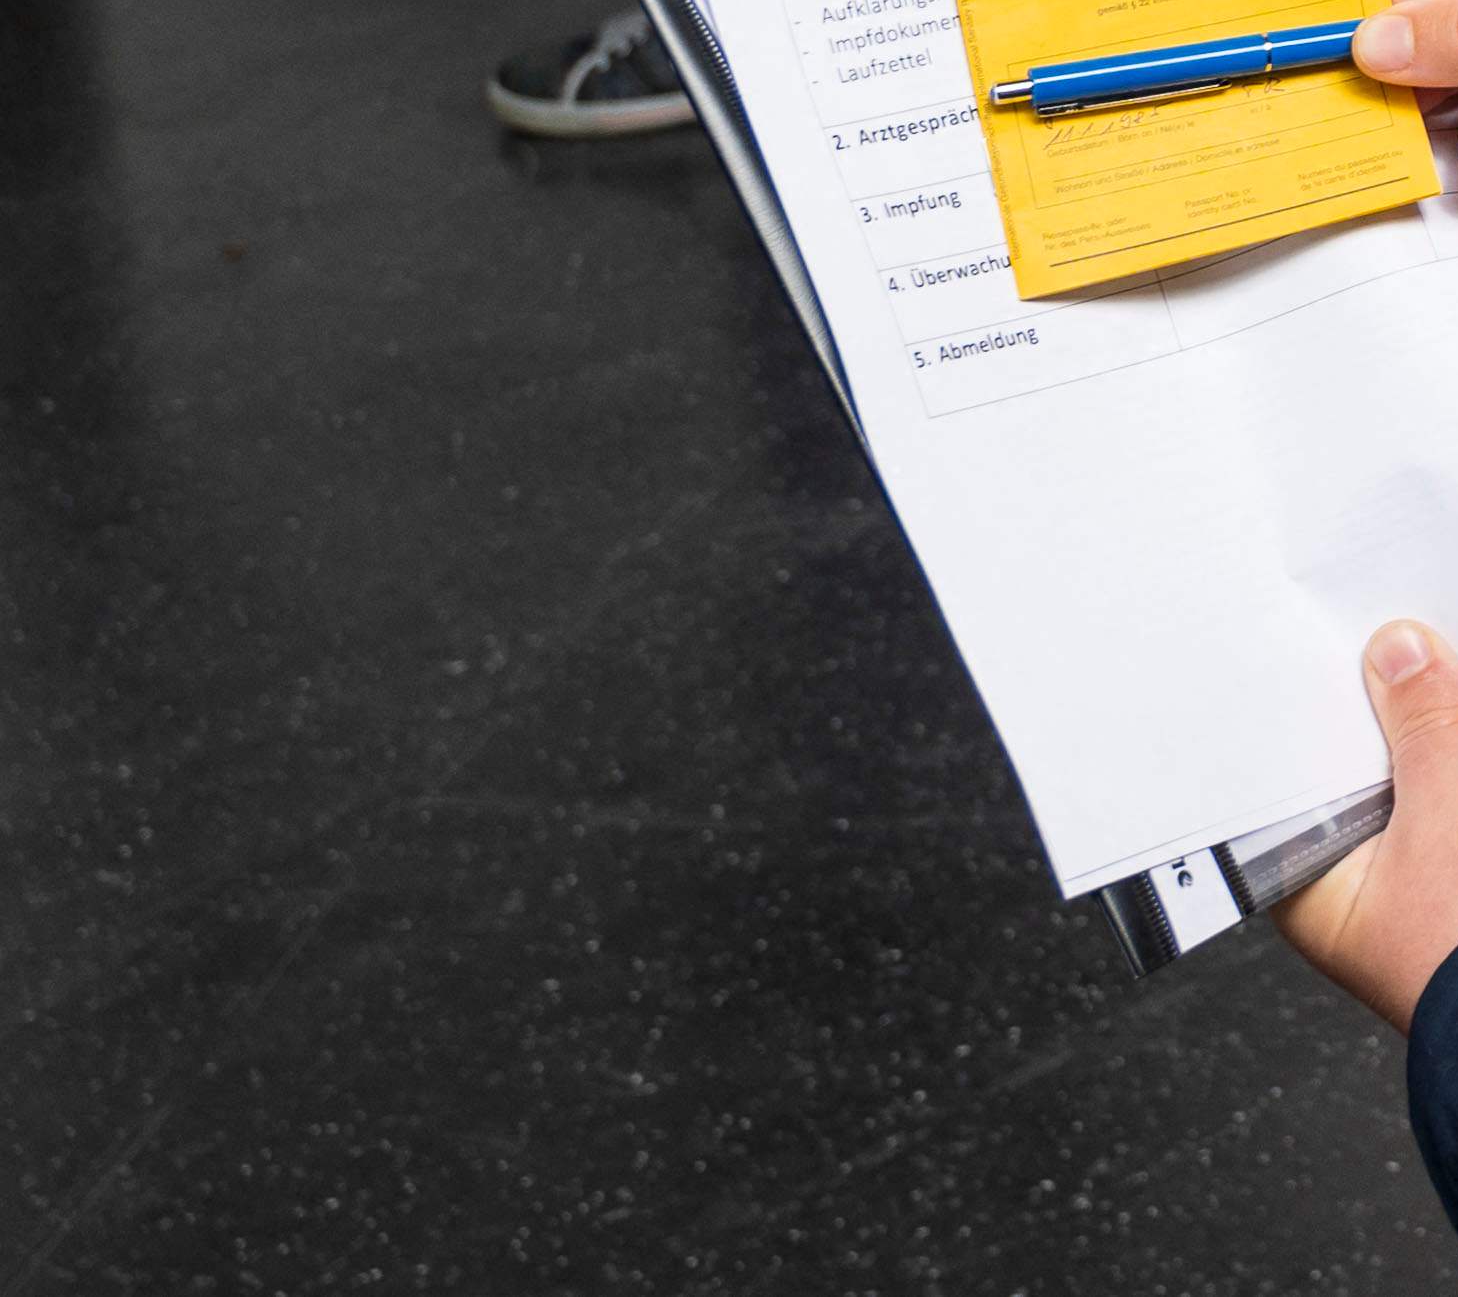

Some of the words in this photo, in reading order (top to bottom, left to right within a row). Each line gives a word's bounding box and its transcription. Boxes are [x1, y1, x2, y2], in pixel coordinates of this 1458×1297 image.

[836, 48, 933, 84] Laufzettel
[832, 134, 850, 151] 2.
[859, 105, 980, 145] Arztgespräch
[860, 207, 878, 224] 3.
[884, 191, 962, 218] Impfung
[888, 277, 906, 293] 4.
[910, 254, 1012, 289] Überwachu
[913, 350, 932, 369] 5.
[939, 326, 1040, 363] Abmeldung
